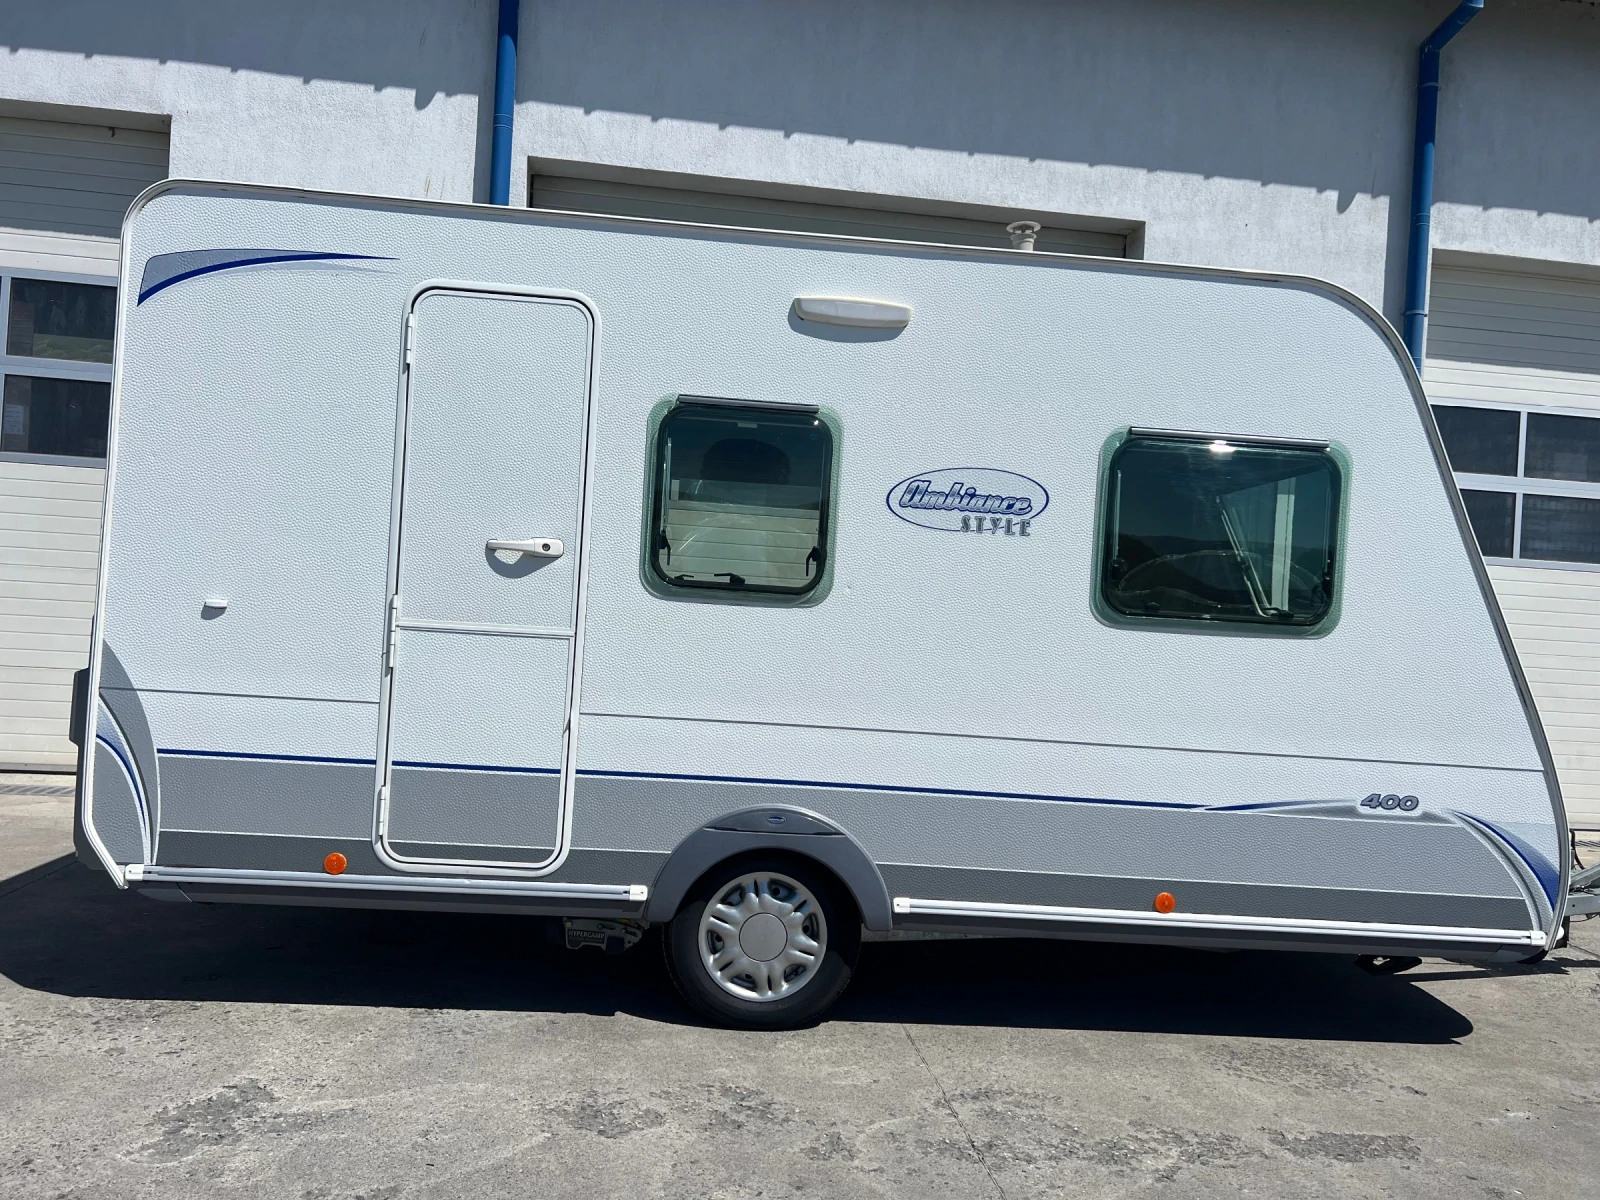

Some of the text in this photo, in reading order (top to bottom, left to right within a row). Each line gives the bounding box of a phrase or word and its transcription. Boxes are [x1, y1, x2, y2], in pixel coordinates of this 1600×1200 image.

[899, 479, 1032, 515] Ambiance
[960, 515, 1031, 536] STYLE
[1360, 793, 1419, 811] 400
[568, 930, 605, 939] HYPERCAMP
